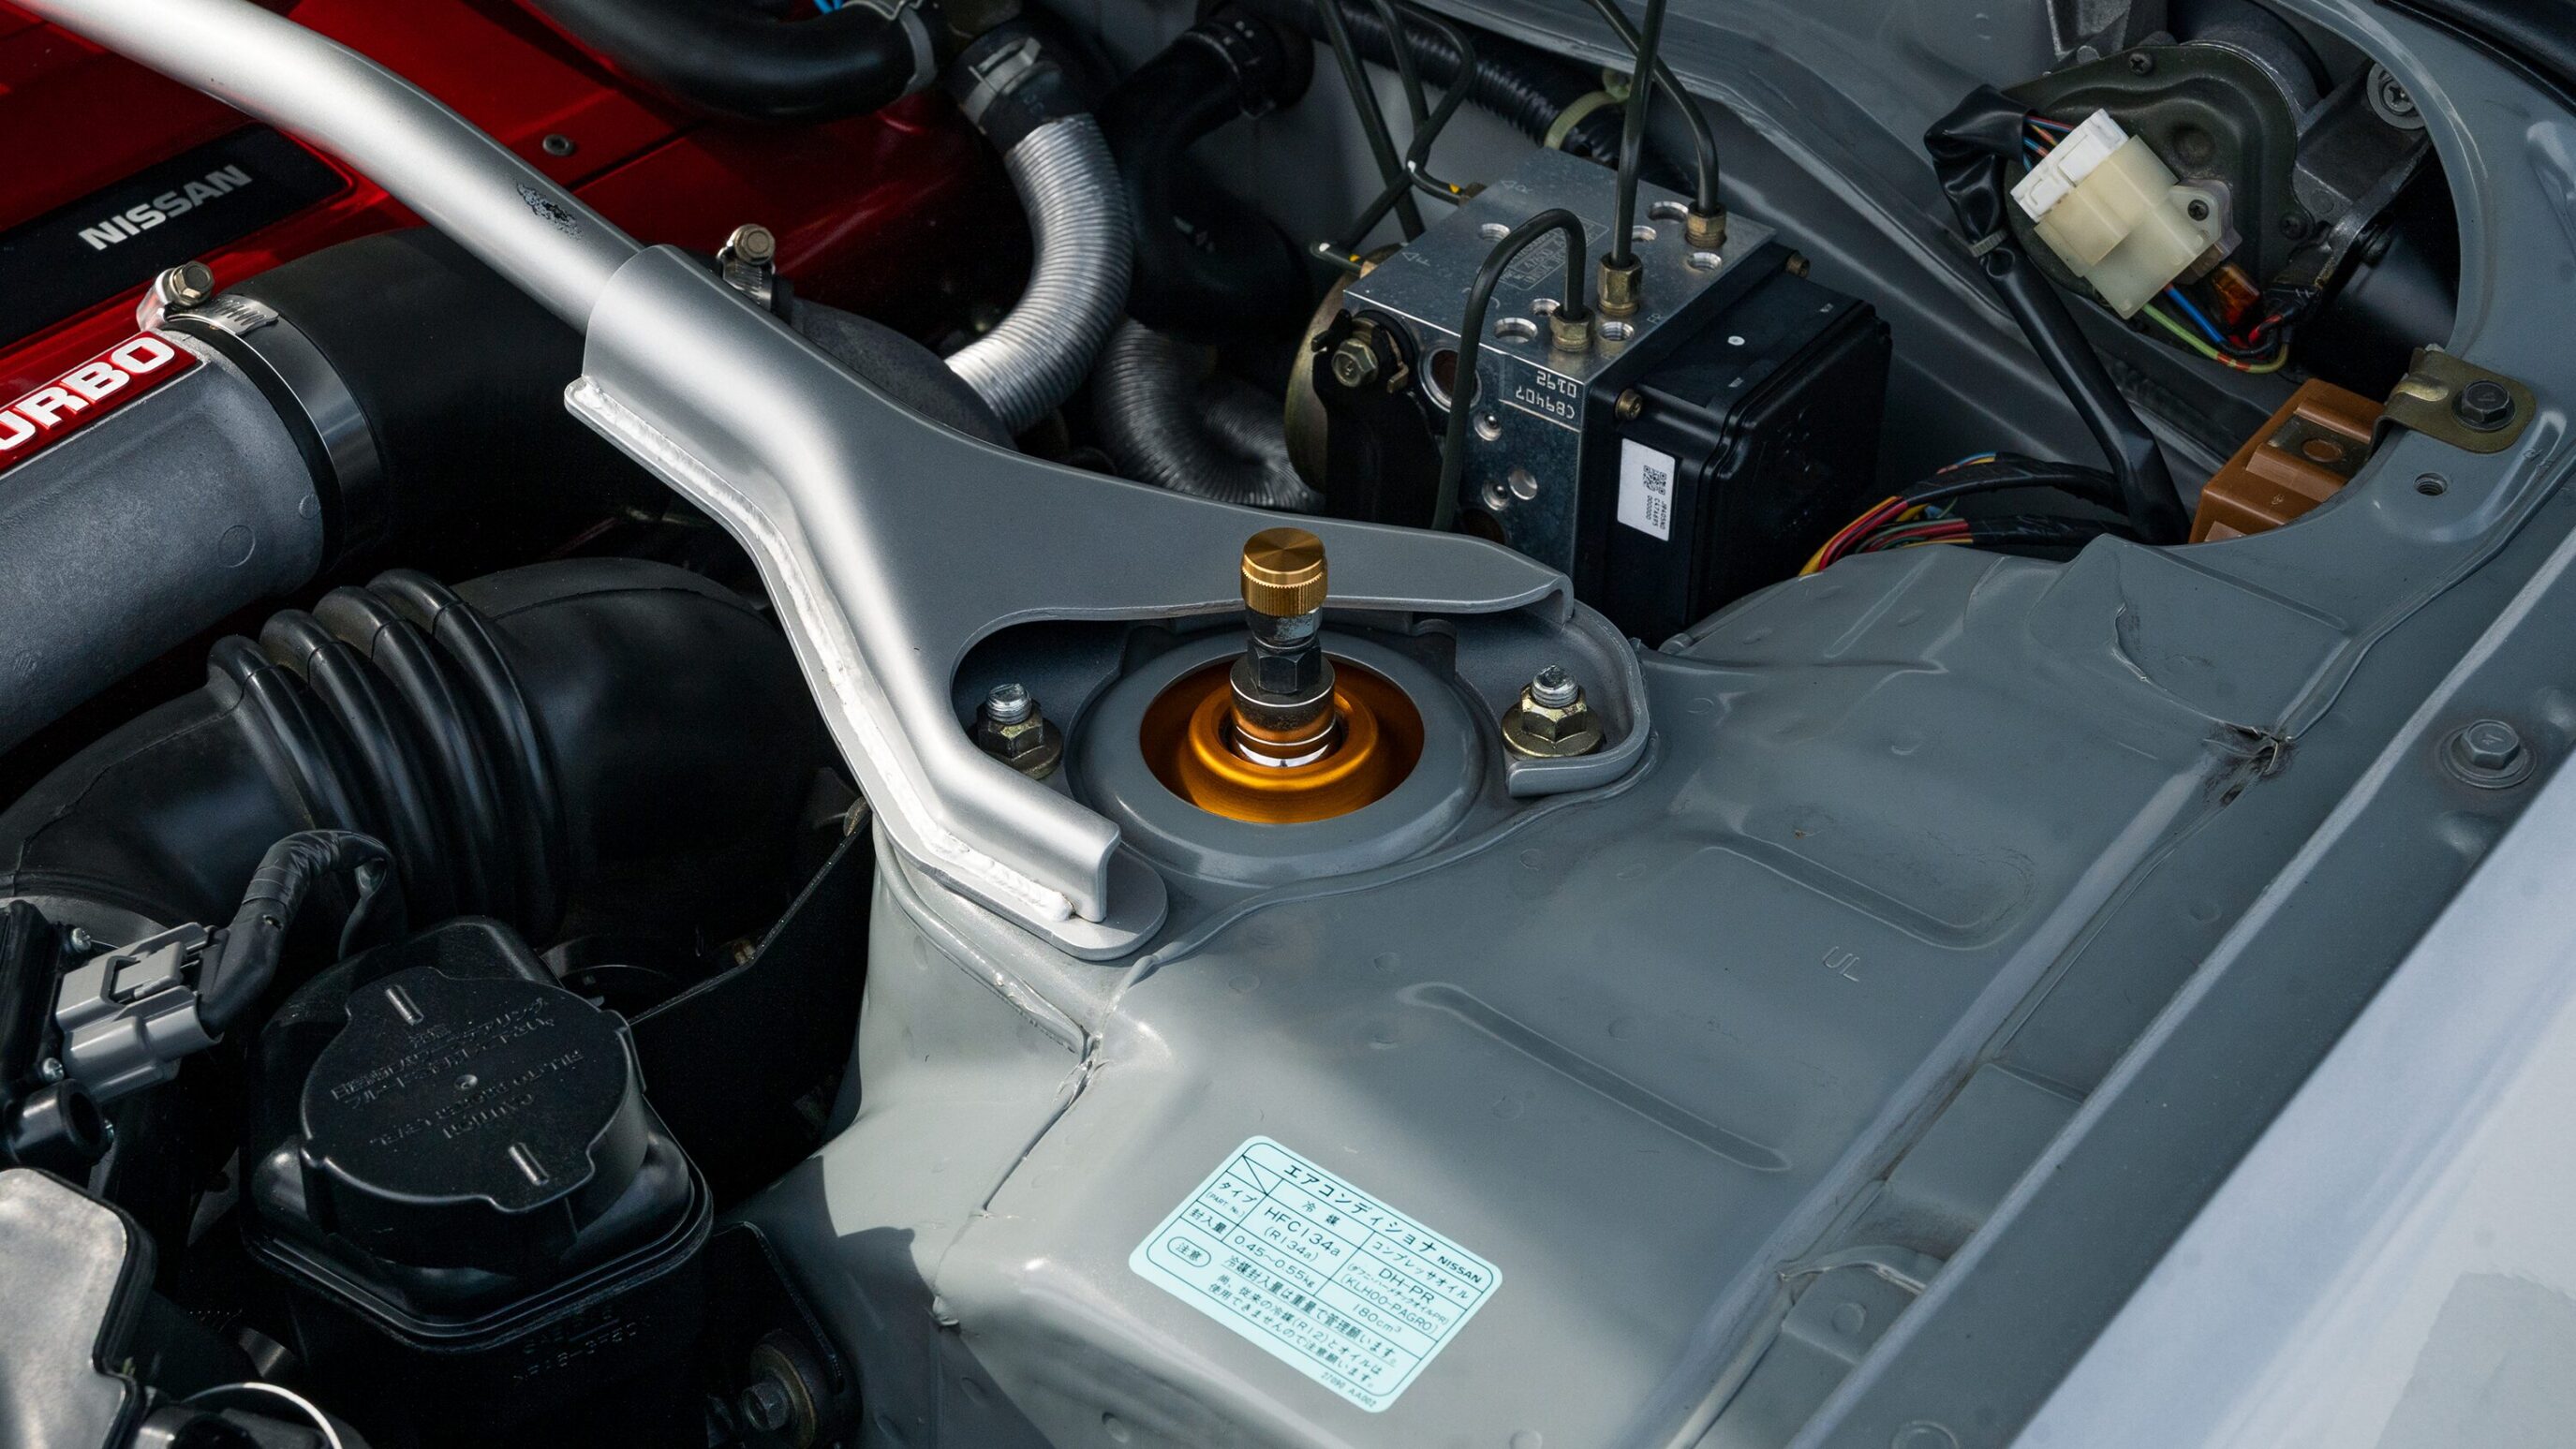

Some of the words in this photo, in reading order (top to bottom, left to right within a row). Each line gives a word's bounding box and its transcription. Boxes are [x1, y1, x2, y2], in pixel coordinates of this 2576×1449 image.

[79, 164, 253, 251] NISSAN
[1536, 370, 1577, 399] 0192
[1219, 1181, 1257, 1203] タイプ
[1189, 1207, 1227, 1234] 封入量
[1263, 1205, 1340, 1257] HFC134a
[1282, 1163, 1437, 1252] エアコンディショナ
[1436, 1254, 1482, 1283] NISSAN
[1175, 1242, 1202, 1261] 注意
[1263, 1225, 1318, 1261] (R134a)
[1377, 1266, 1435, 1304] DH-PR
